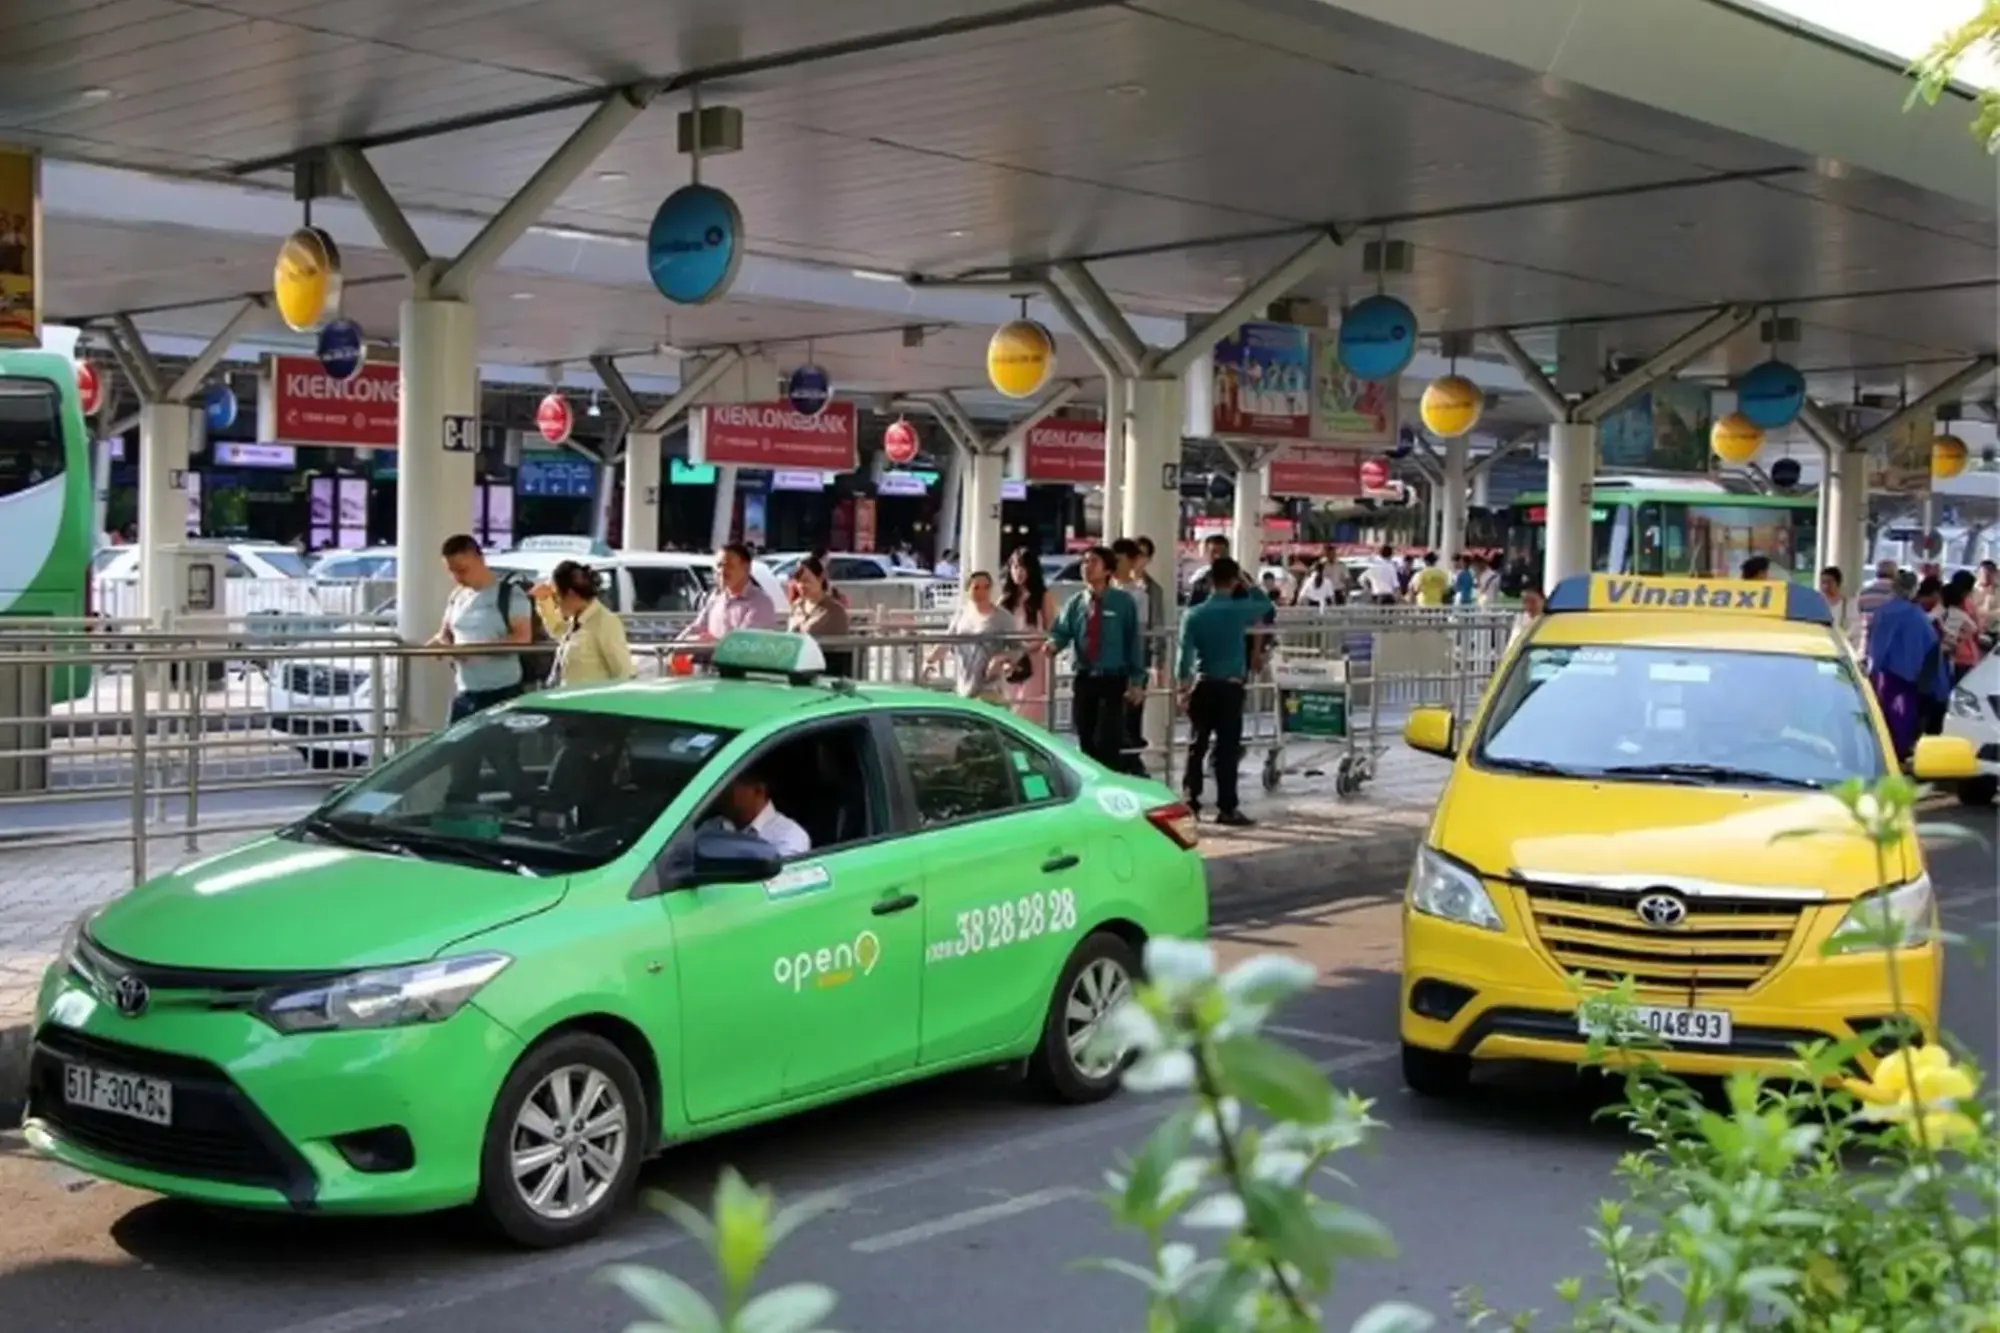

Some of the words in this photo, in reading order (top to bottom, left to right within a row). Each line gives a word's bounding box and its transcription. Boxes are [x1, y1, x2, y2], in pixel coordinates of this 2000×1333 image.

[1606, 580, 1773, 609] Vinataxi
[956, 909, 984, 956] 38
[987, 900, 1015, 948] 28
[1018, 891, 1044, 939] 28
[1049, 887, 1077, 932] 28
